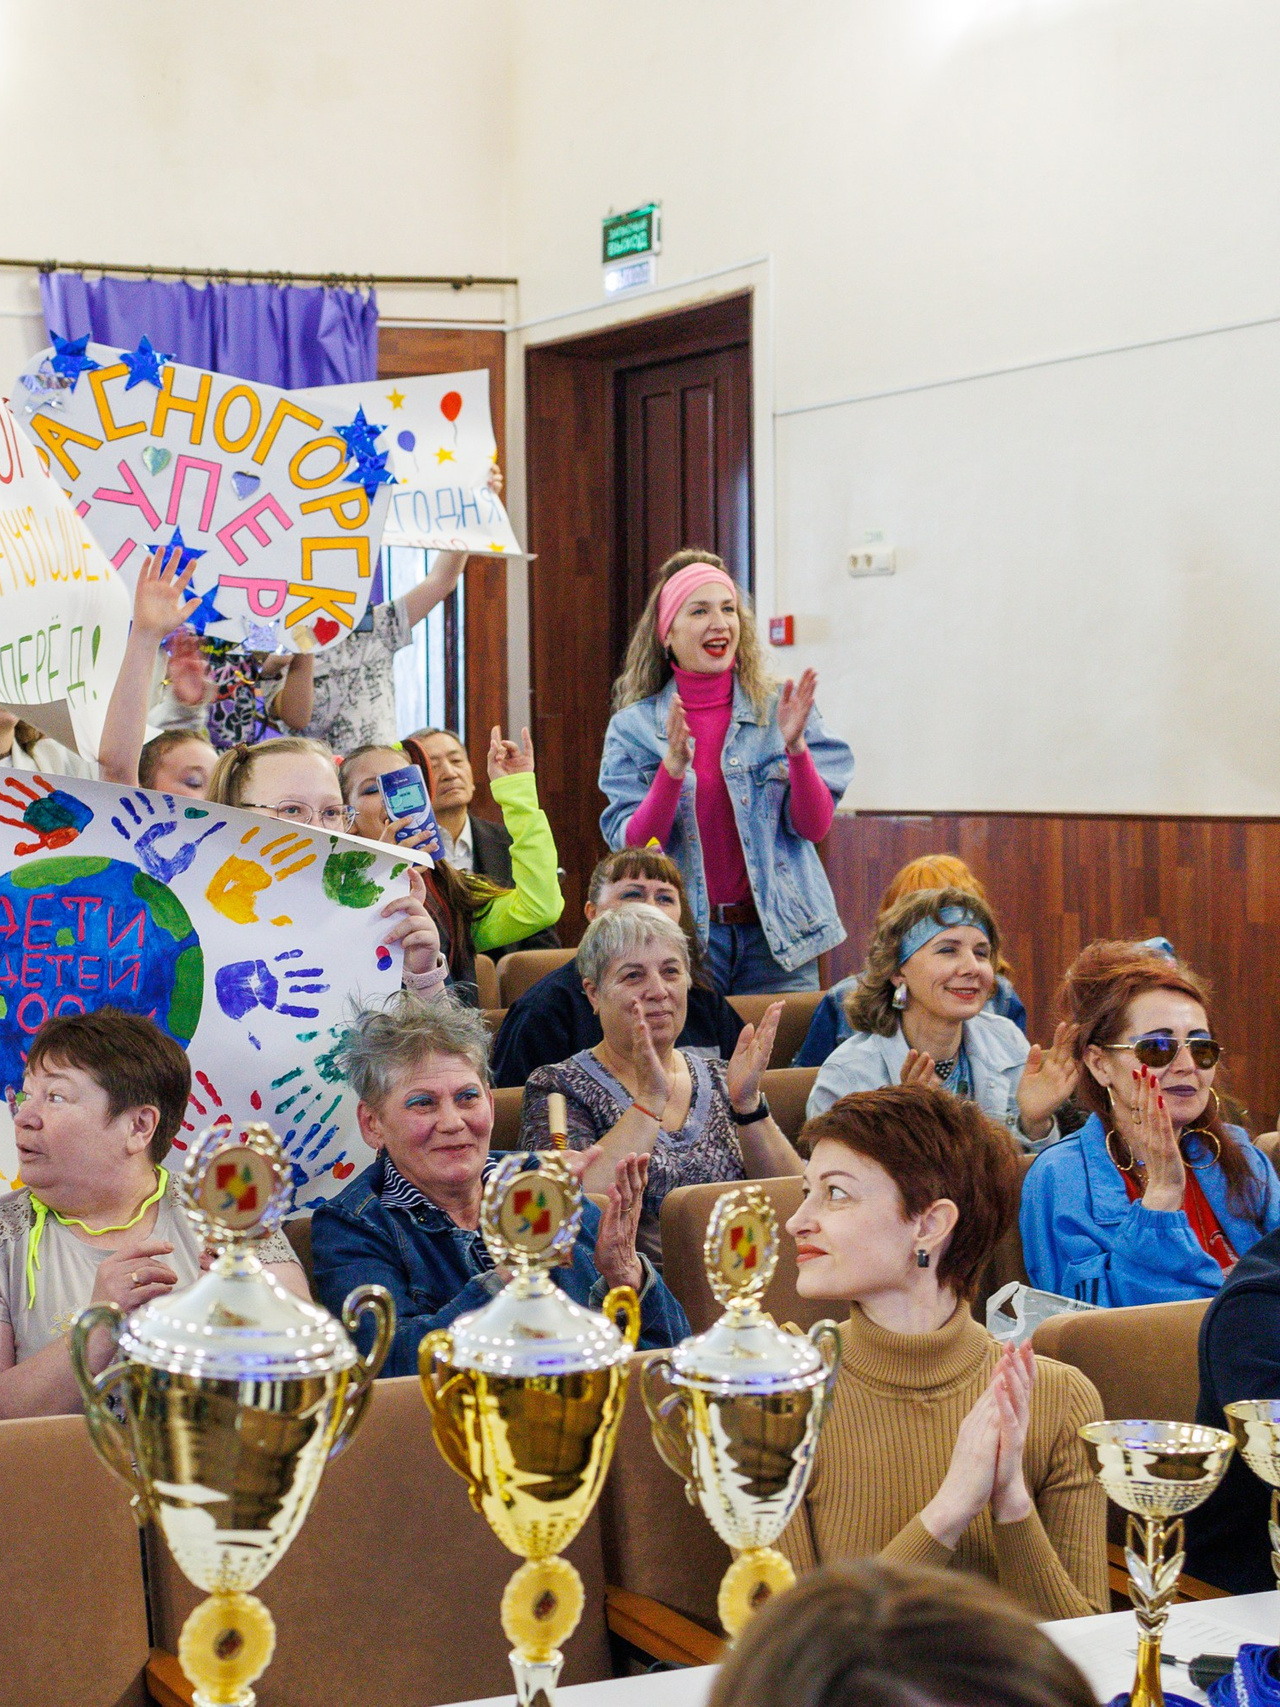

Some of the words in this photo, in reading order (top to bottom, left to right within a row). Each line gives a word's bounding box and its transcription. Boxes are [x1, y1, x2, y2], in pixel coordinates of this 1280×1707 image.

[30, 363, 371, 630] АСНОГОРСК
[76, 455, 293, 617] УПЕР
[384, 487, 502, 534] ГОДНЯ
